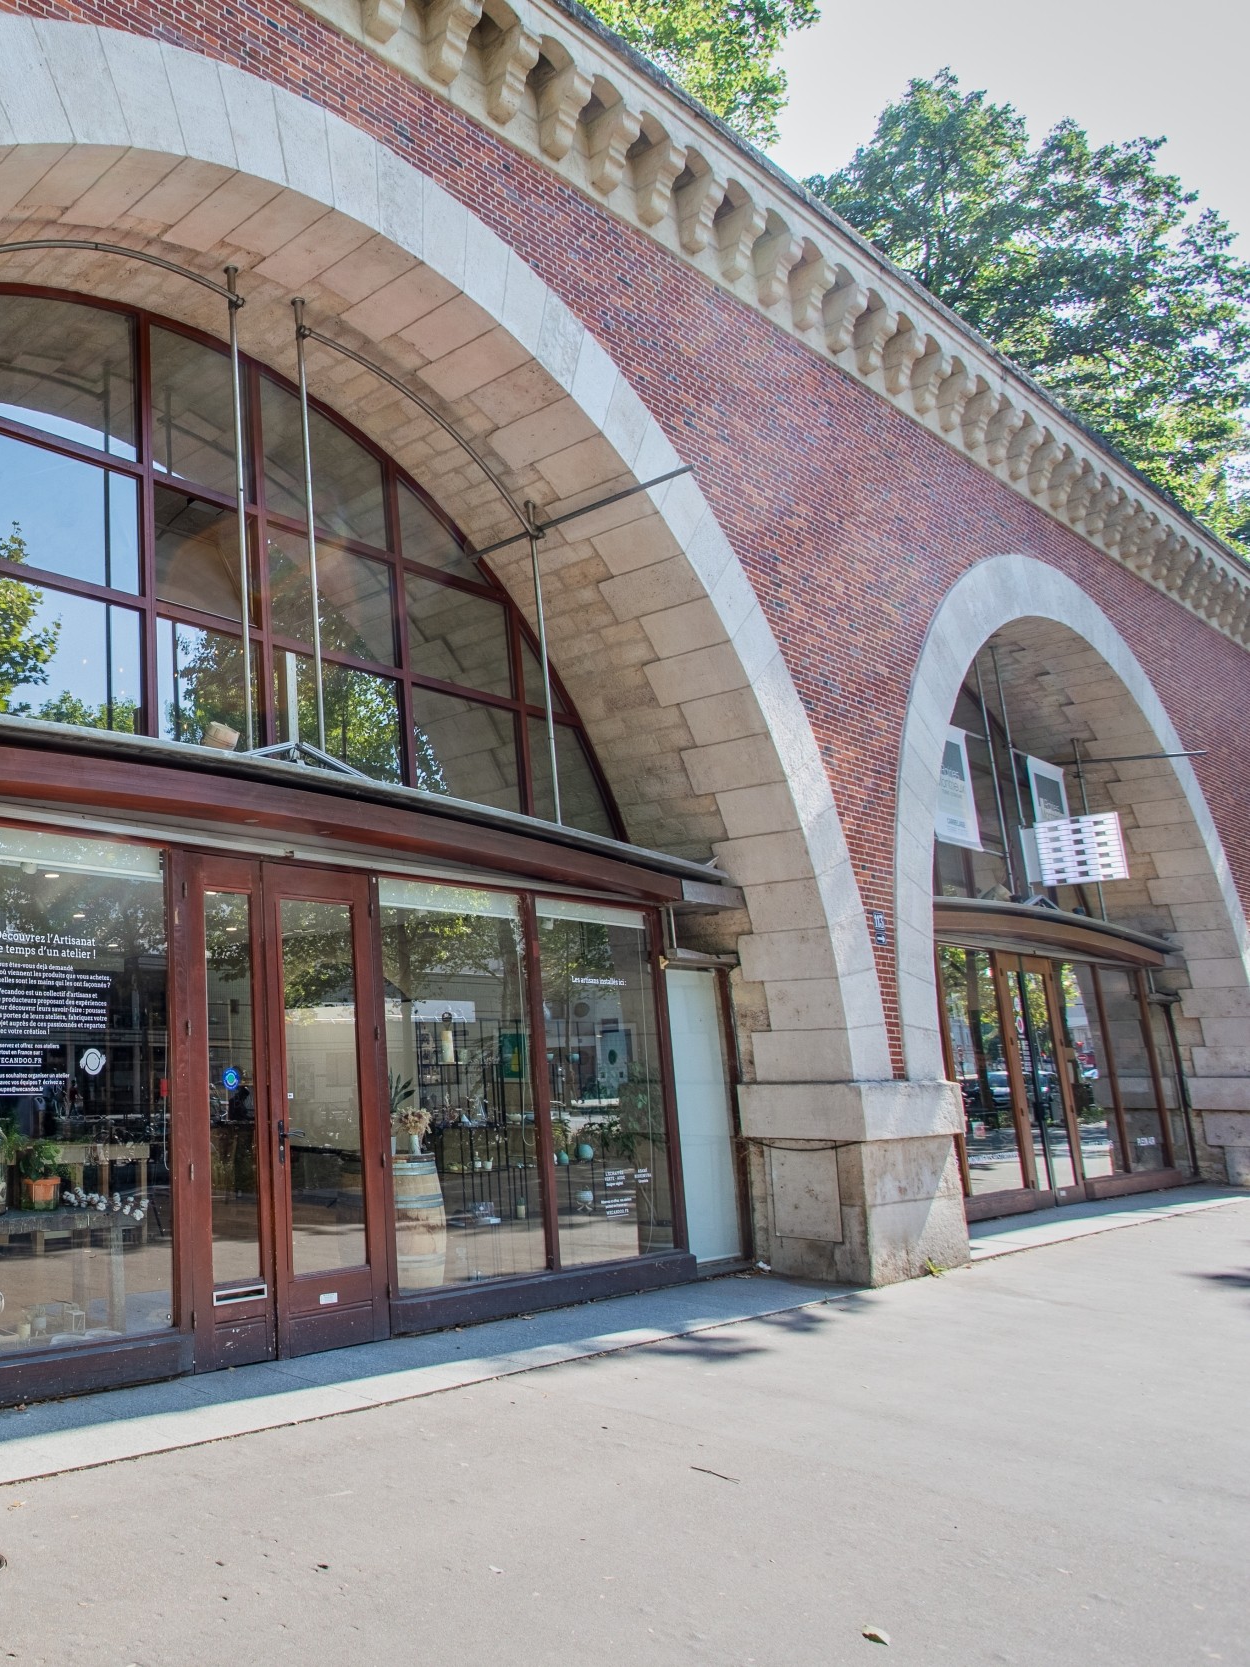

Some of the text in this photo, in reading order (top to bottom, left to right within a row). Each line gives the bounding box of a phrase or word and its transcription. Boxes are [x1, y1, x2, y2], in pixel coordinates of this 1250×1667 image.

[47, 934, 96, 946] l'Artisanat
[6, 945, 35, 957] temps
[38, 946, 59, 956] d'un
[61, 949, 91, 959] atelier
[93, 950, 96, 959] !
[49, 963, 73, 971] demandé
[76, 1000, 107, 1008] expériences
